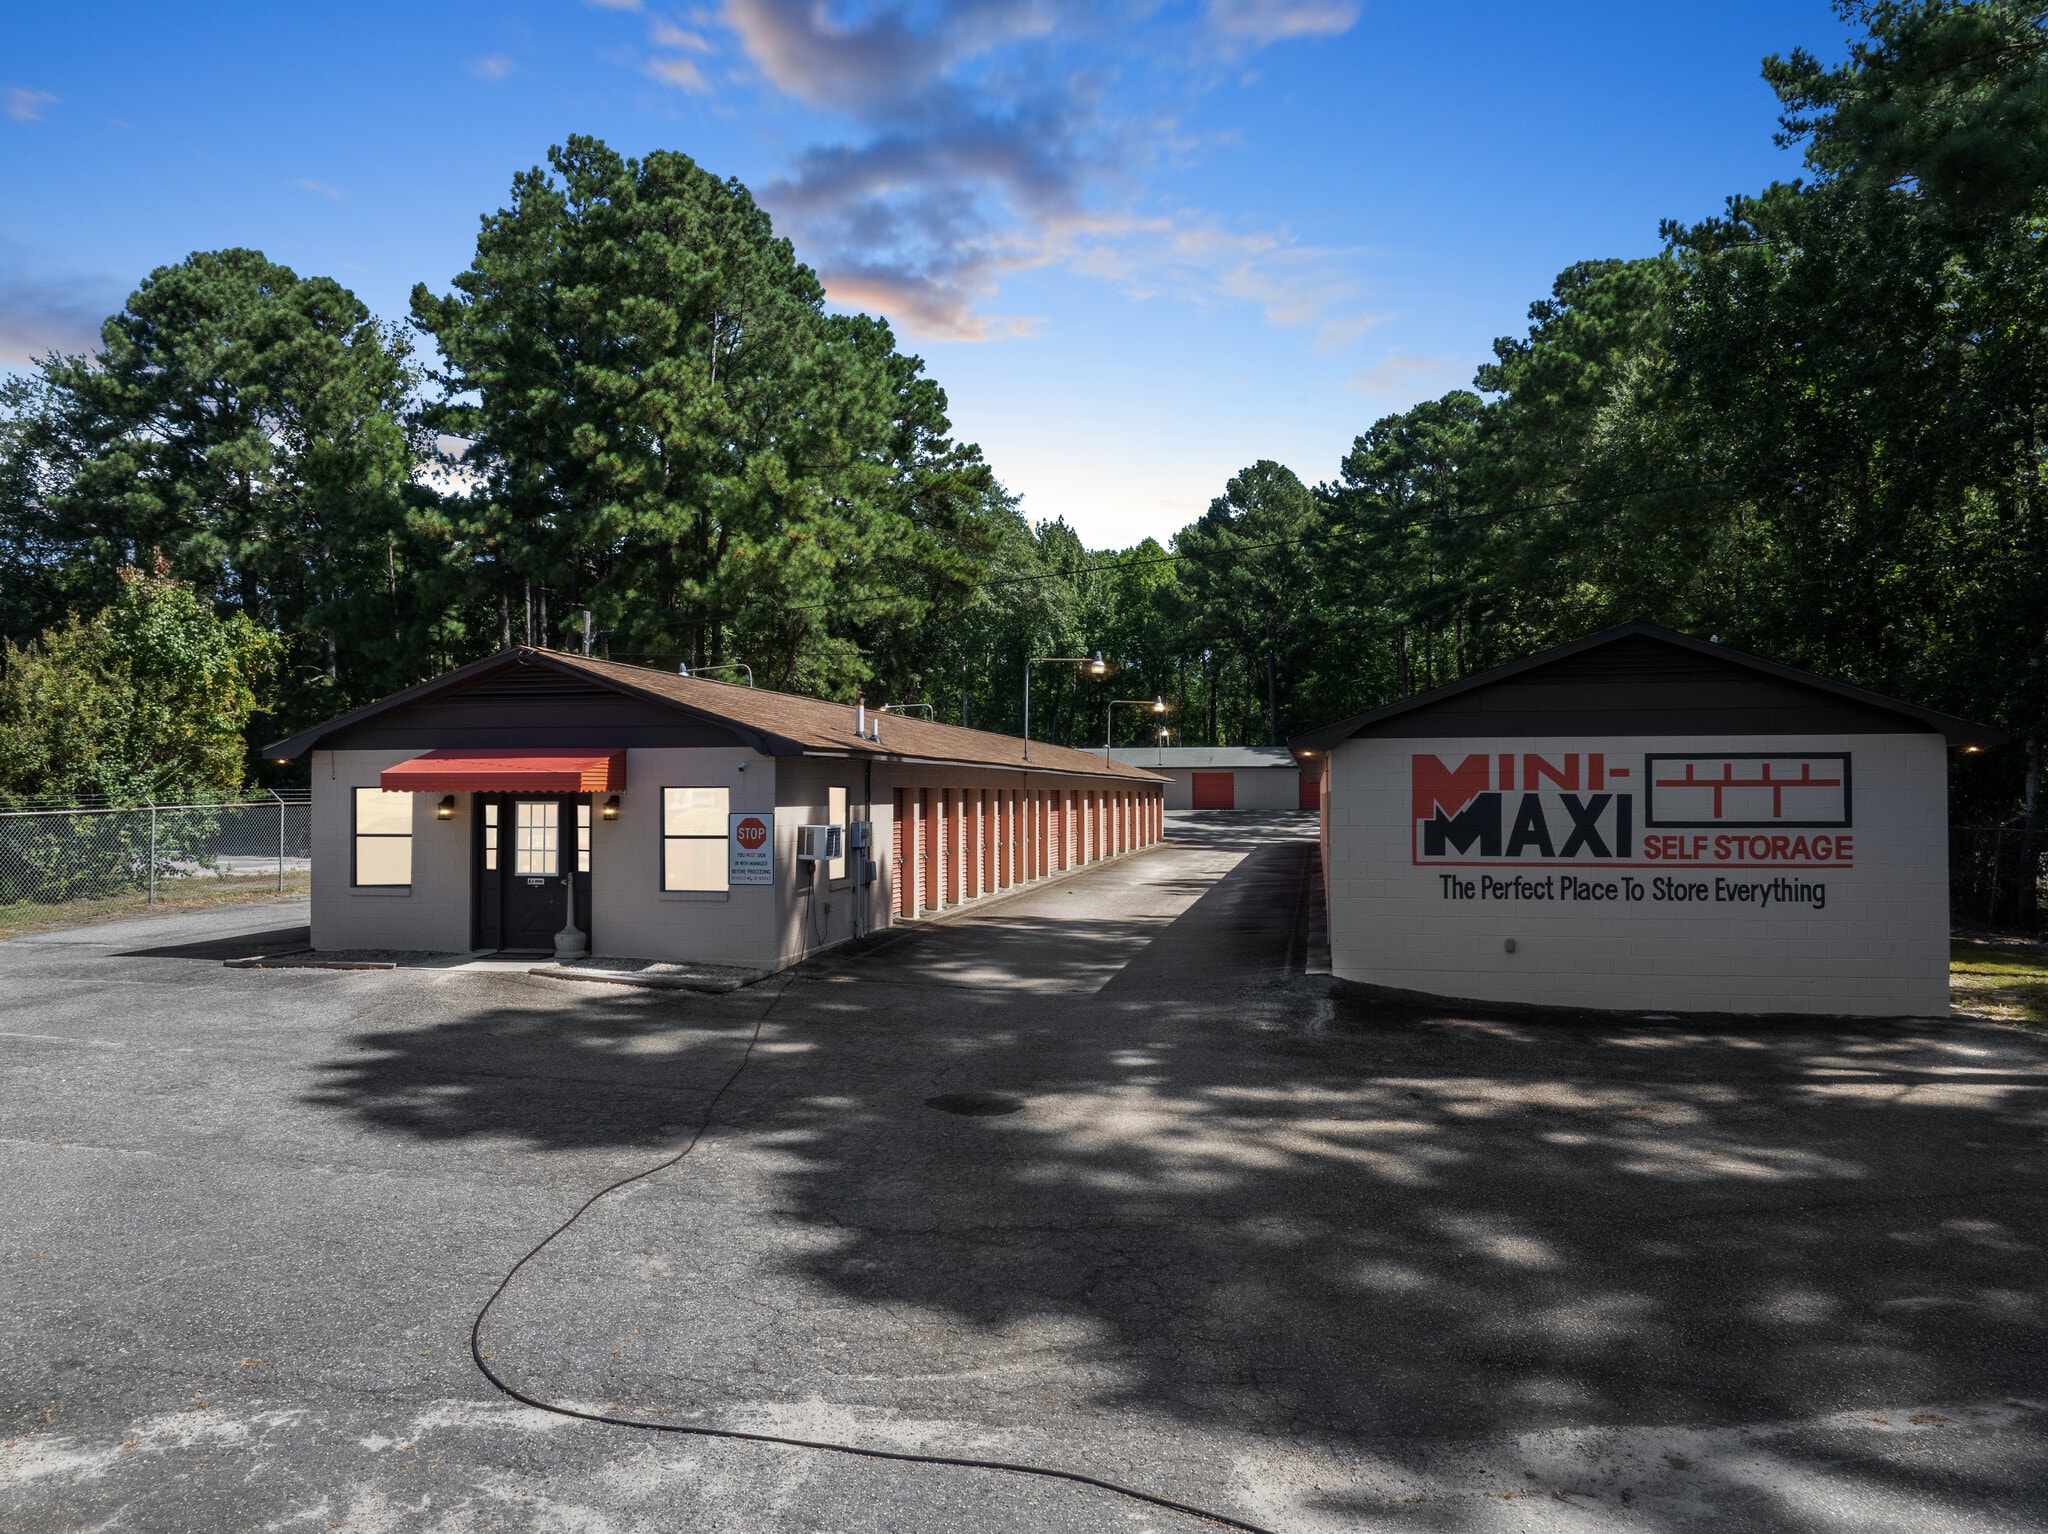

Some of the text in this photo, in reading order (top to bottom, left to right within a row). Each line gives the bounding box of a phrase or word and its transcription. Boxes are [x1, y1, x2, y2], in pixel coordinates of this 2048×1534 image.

[1412, 753, 1630, 819] MINI-
[738, 827, 765, 840] STOP
[1424, 792, 1632, 858] MAXI
[1643, 835, 1853, 860] SELF STORAGE
[1439, 874, 1825, 909] The Perfect Place To Store Everything
